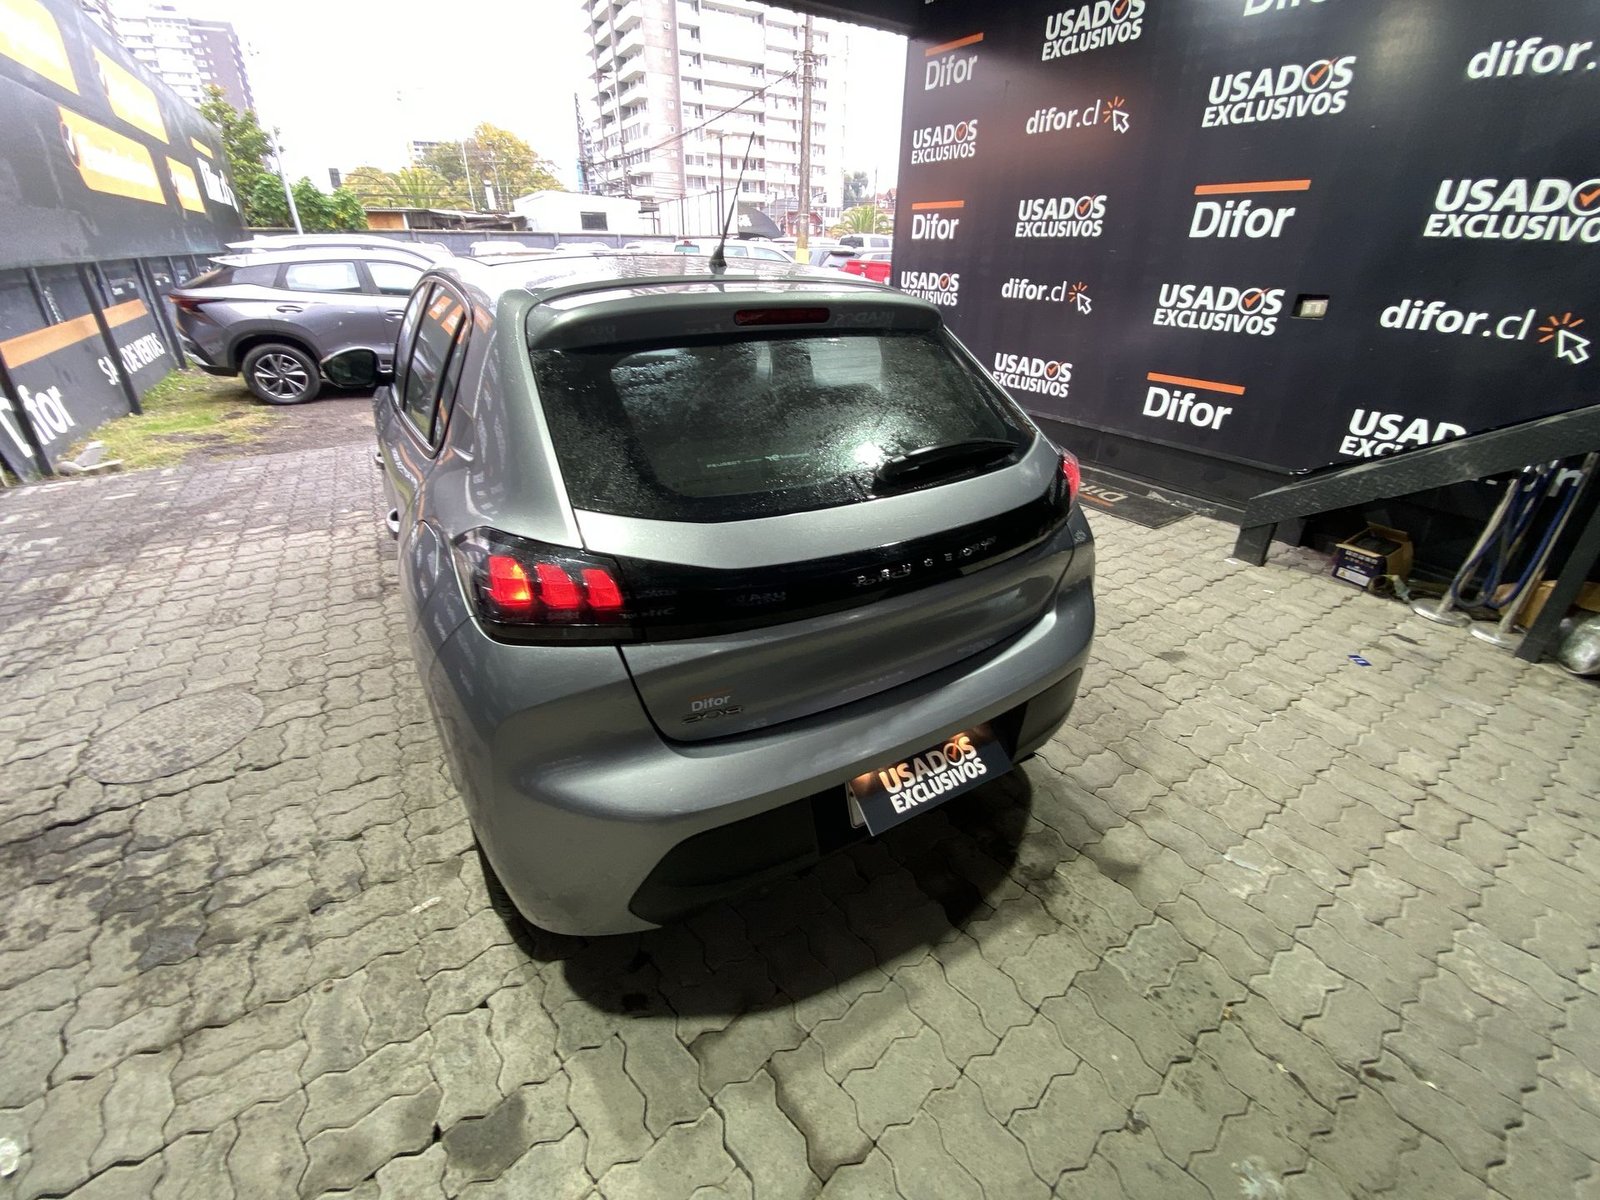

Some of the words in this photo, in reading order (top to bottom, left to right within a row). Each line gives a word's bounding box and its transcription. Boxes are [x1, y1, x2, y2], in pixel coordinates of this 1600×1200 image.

[1045, 0, 1146, 41] USADOS
[1041, 18, 1143, 61] EXCLUSIVOS
[925, 54, 978, 90] Difor
[1208, 56, 1356, 105] USADOS
[1025, 98, 1101, 135] difor.cl
[1201, 90, 1349, 128] EXCLUSIVOS
[912, 119, 978, 149] USADOS
[911, 141, 976, 164] EXCLUSIVOS
[1018, 194, 1107, 221] USADOS
[1188, 200, 1296, 238] Difor
[911, 214, 960, 240] Difor
[1014, 218, 1103, 238] EXCLUSIVOS
[900, 271, 960, 293] USADOS
[1001, 277, 1067, 302] difor.cl
[1158, 283, 1286, 316] USADOS
[1153, 308, 1278, 336] EXCLUSIVOS
[1379, 298, 1537, 341] difor.cl
[993, 352, 1073, 383] USADOS
[992, 371, 1070, 398] EXCLUSIVOS
[1142, 386, 1233, 430] Difor
[691, 695, 731, 712] Difor
[879, 735, 978, 794] USADOS
[890, 757, 987, 814] EXCLUSIVOS
